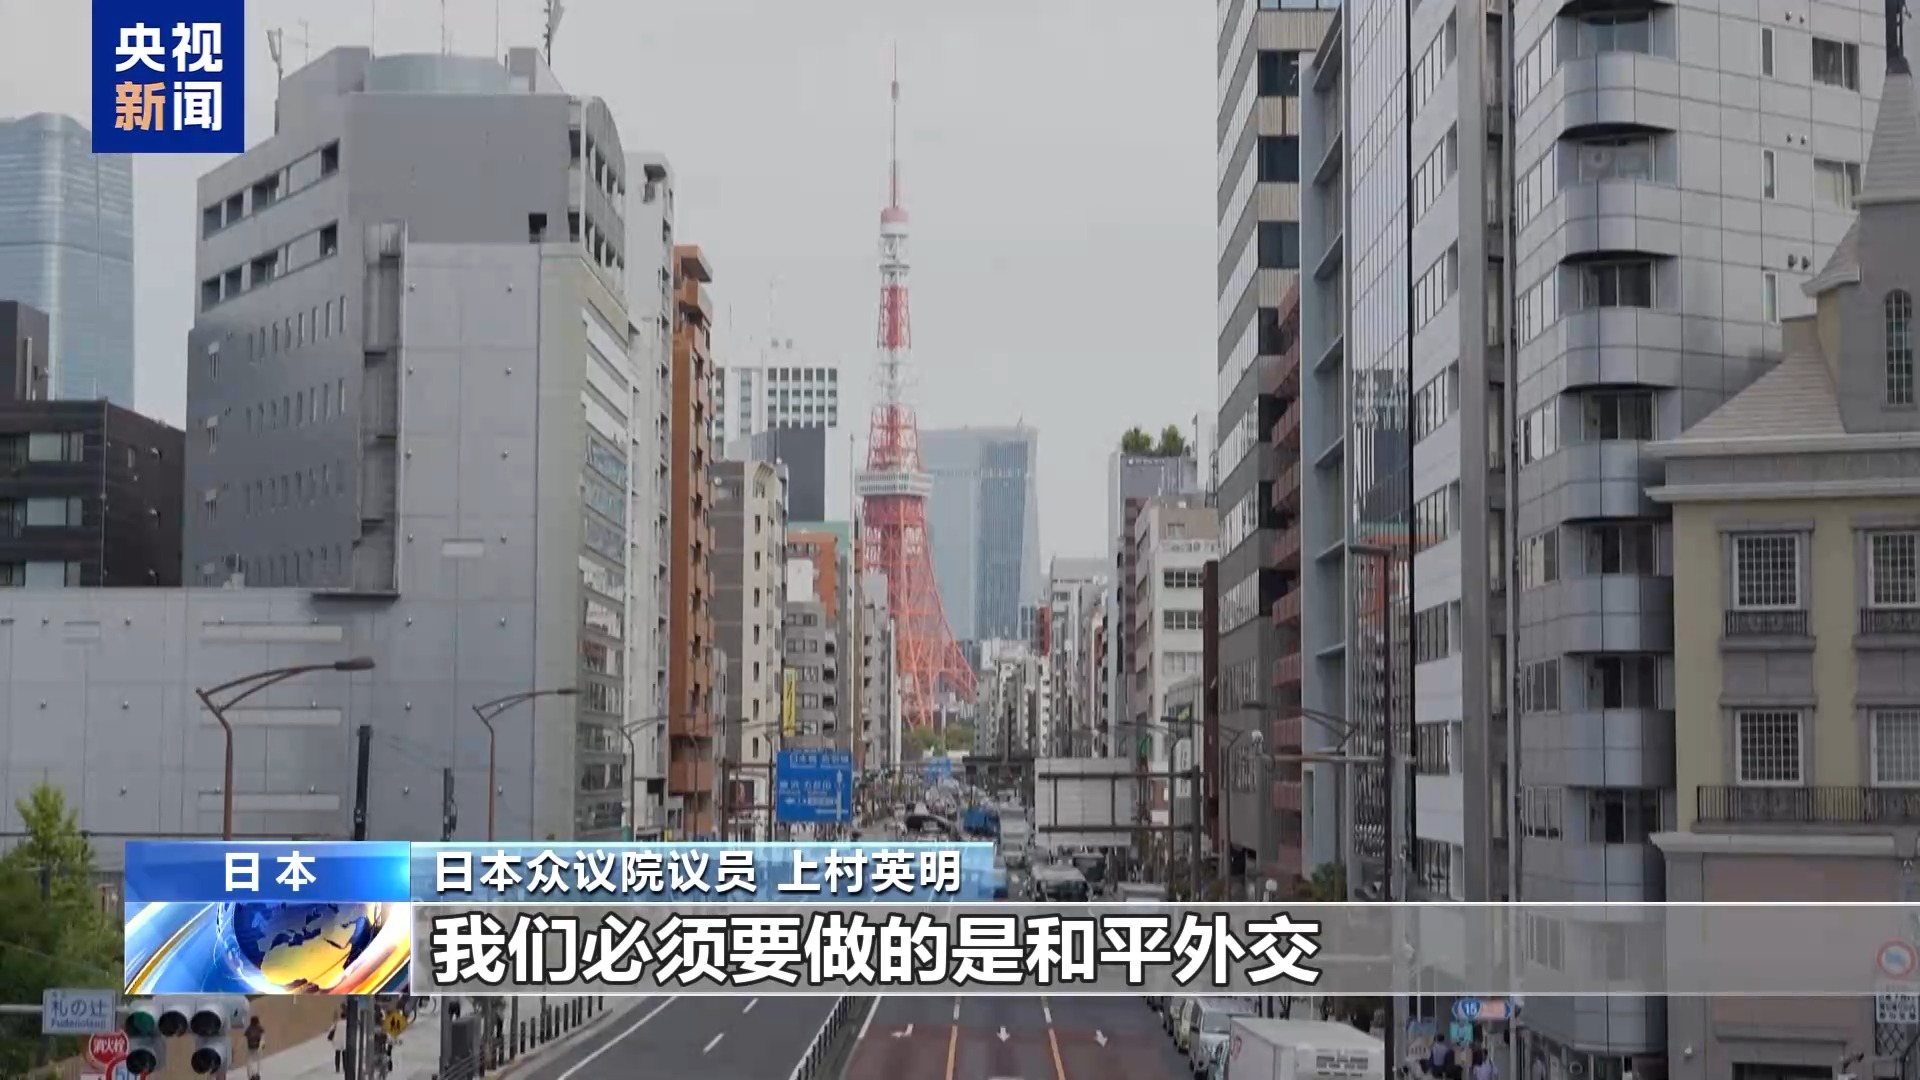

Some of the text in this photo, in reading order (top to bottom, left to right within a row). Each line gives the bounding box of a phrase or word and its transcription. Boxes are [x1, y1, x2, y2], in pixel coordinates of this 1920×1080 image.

[51, 999, 109, 1017] 札の辻
[94, 1037, 126, 1054] 消火栓
